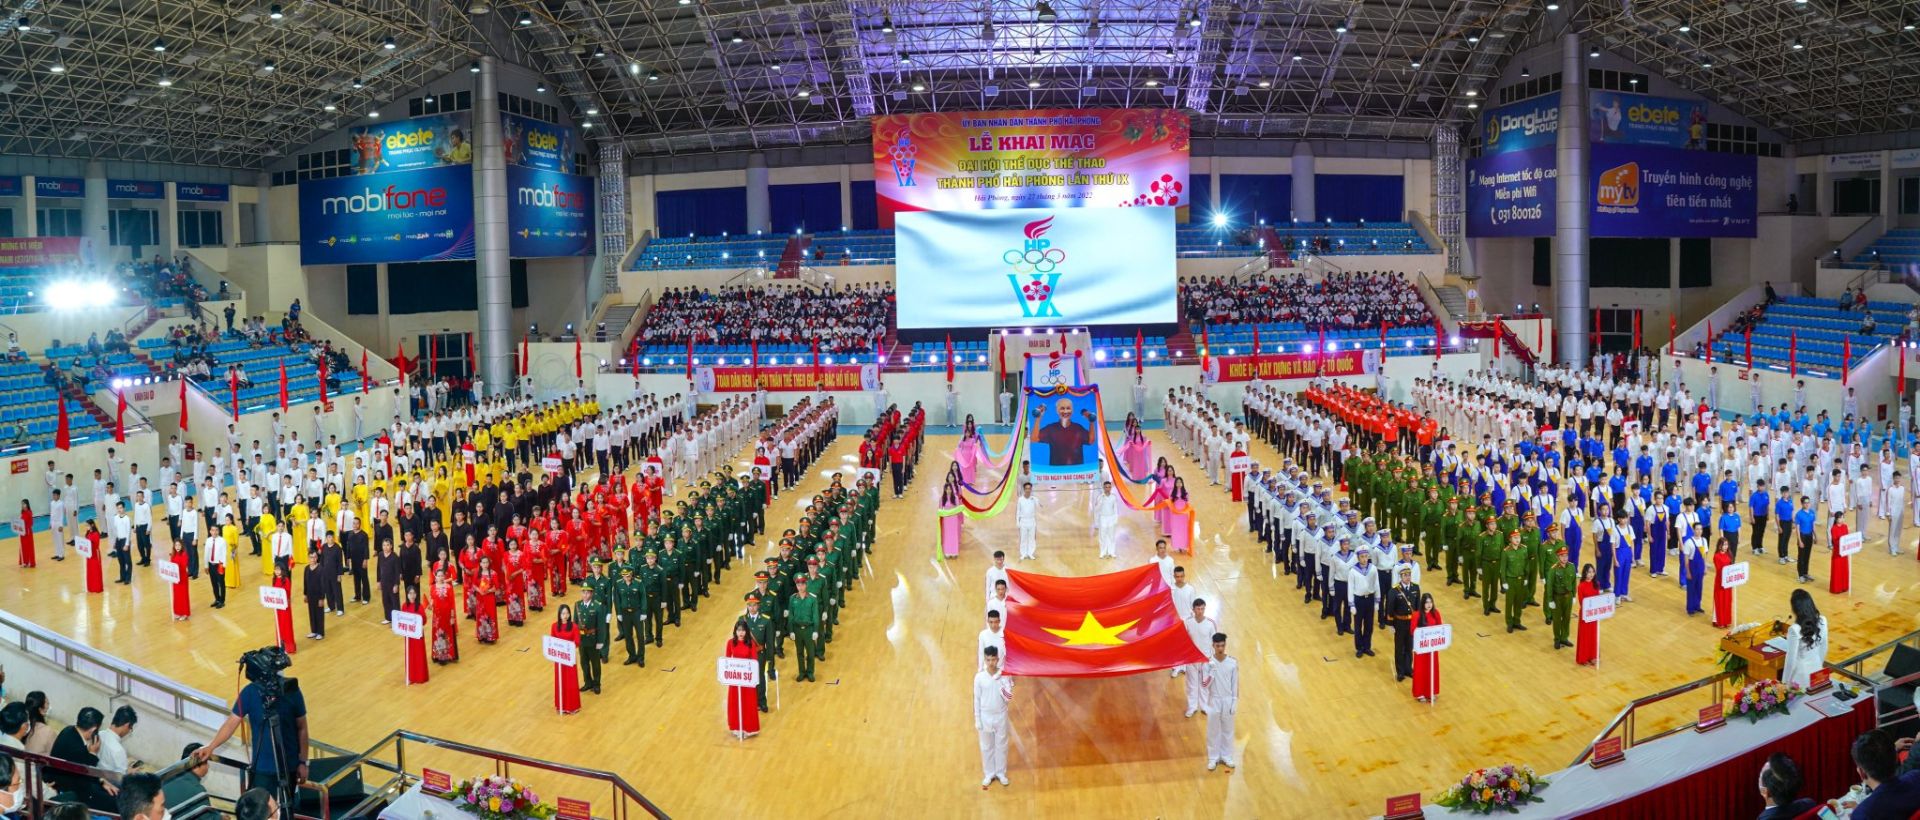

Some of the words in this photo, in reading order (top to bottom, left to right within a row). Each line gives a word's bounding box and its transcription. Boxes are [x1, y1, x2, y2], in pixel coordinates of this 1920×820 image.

[969, 131, 993, 151] LỄ
[998, 135, 1045, 151] KHAI
[1050, 134, 1095, 152] MẠC
[958, 159, 979, 173] ĐẠI
[981, 158, 1000, 173] HỘI
[1004, 155, 1026, 170] THỂ
[1028, 158, 1050, 172] DỤC
[1077, 157, 1106, 169] THAO
[937, 175, 974, 189] THÀNH
[977, 173, 1000, 188] PHỐ
[1003, 174, 1023, 187] HẢI
[1025, 173, 1064, 187] PHÒNG
[1117, 173, 1129, 185] IX
[1479, 175, 1495, 187] Mạng
[1496, 172, 1520, 184] Internet
[1544, 169, 1557, 178] cao
[1704, 174, 1727, 189] công
[1730, 175, 1752, 191] nghệ
[322, 185, 447, 215] mobifone
[518, 183, 584, 209] mobifone
[1523, 186, 1537, 198] Wifi
[1600, 183, 1637, 204] mytv
[1710, 193, 1732, 208] nhất
[420, 210, 433, 218] mọi
[1498, 208, 1510, 223] 031
[1512, 204, 1541, 220] 800126
[1024, 238, 1050, 252] HP
[1230, 359, 1247, 377] KHỎE
[1259, 359, 1272, 377] XÂY
[1273, 360, 1292, 377] DỰNG
[1336, 353, 1353, 372] QUỐC
[793, 372, 806, 387] THEO
[724, 669, 742, 680] QUÂN
